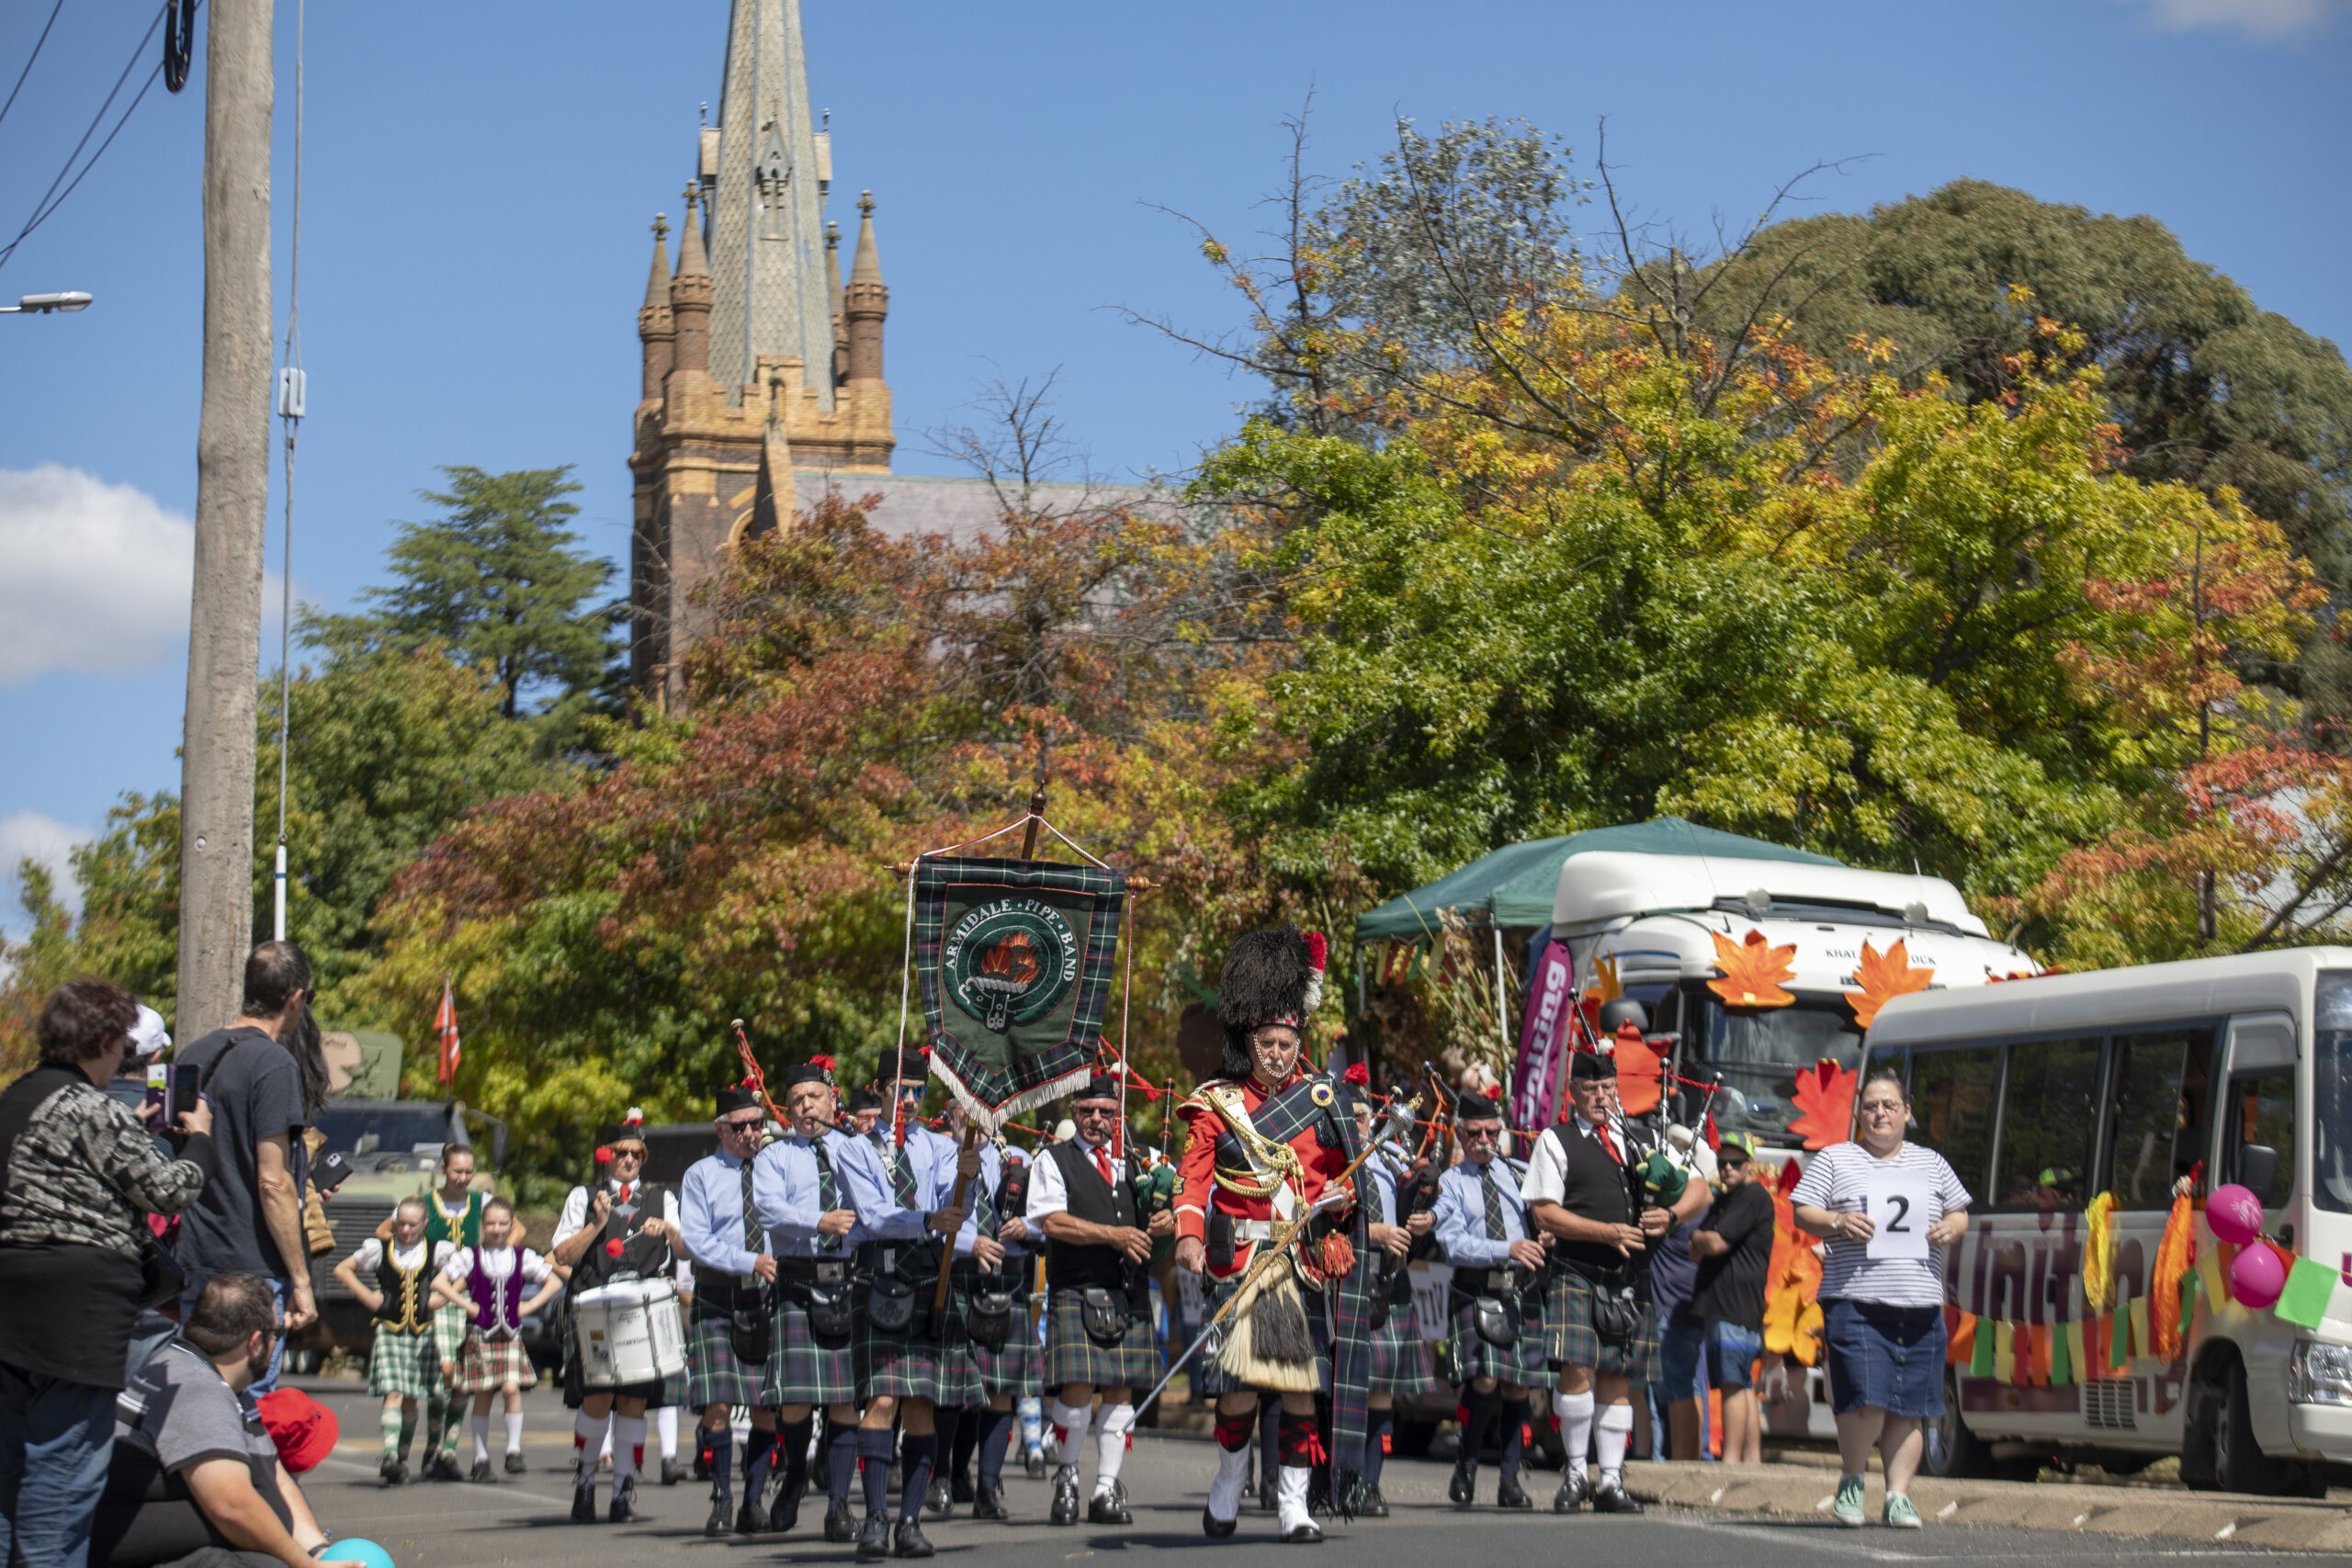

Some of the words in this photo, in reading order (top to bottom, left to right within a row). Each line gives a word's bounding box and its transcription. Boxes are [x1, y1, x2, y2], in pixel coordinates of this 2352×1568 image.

[945, 898, 1012, 970] ARMIDALE
[1025, 898, 1058, 925] PIPE
[1060, 931, 1078, 982] BAND
[1912, 953, 1936, 965] OCK
[1885, 1194, 1911, 1233] 2
